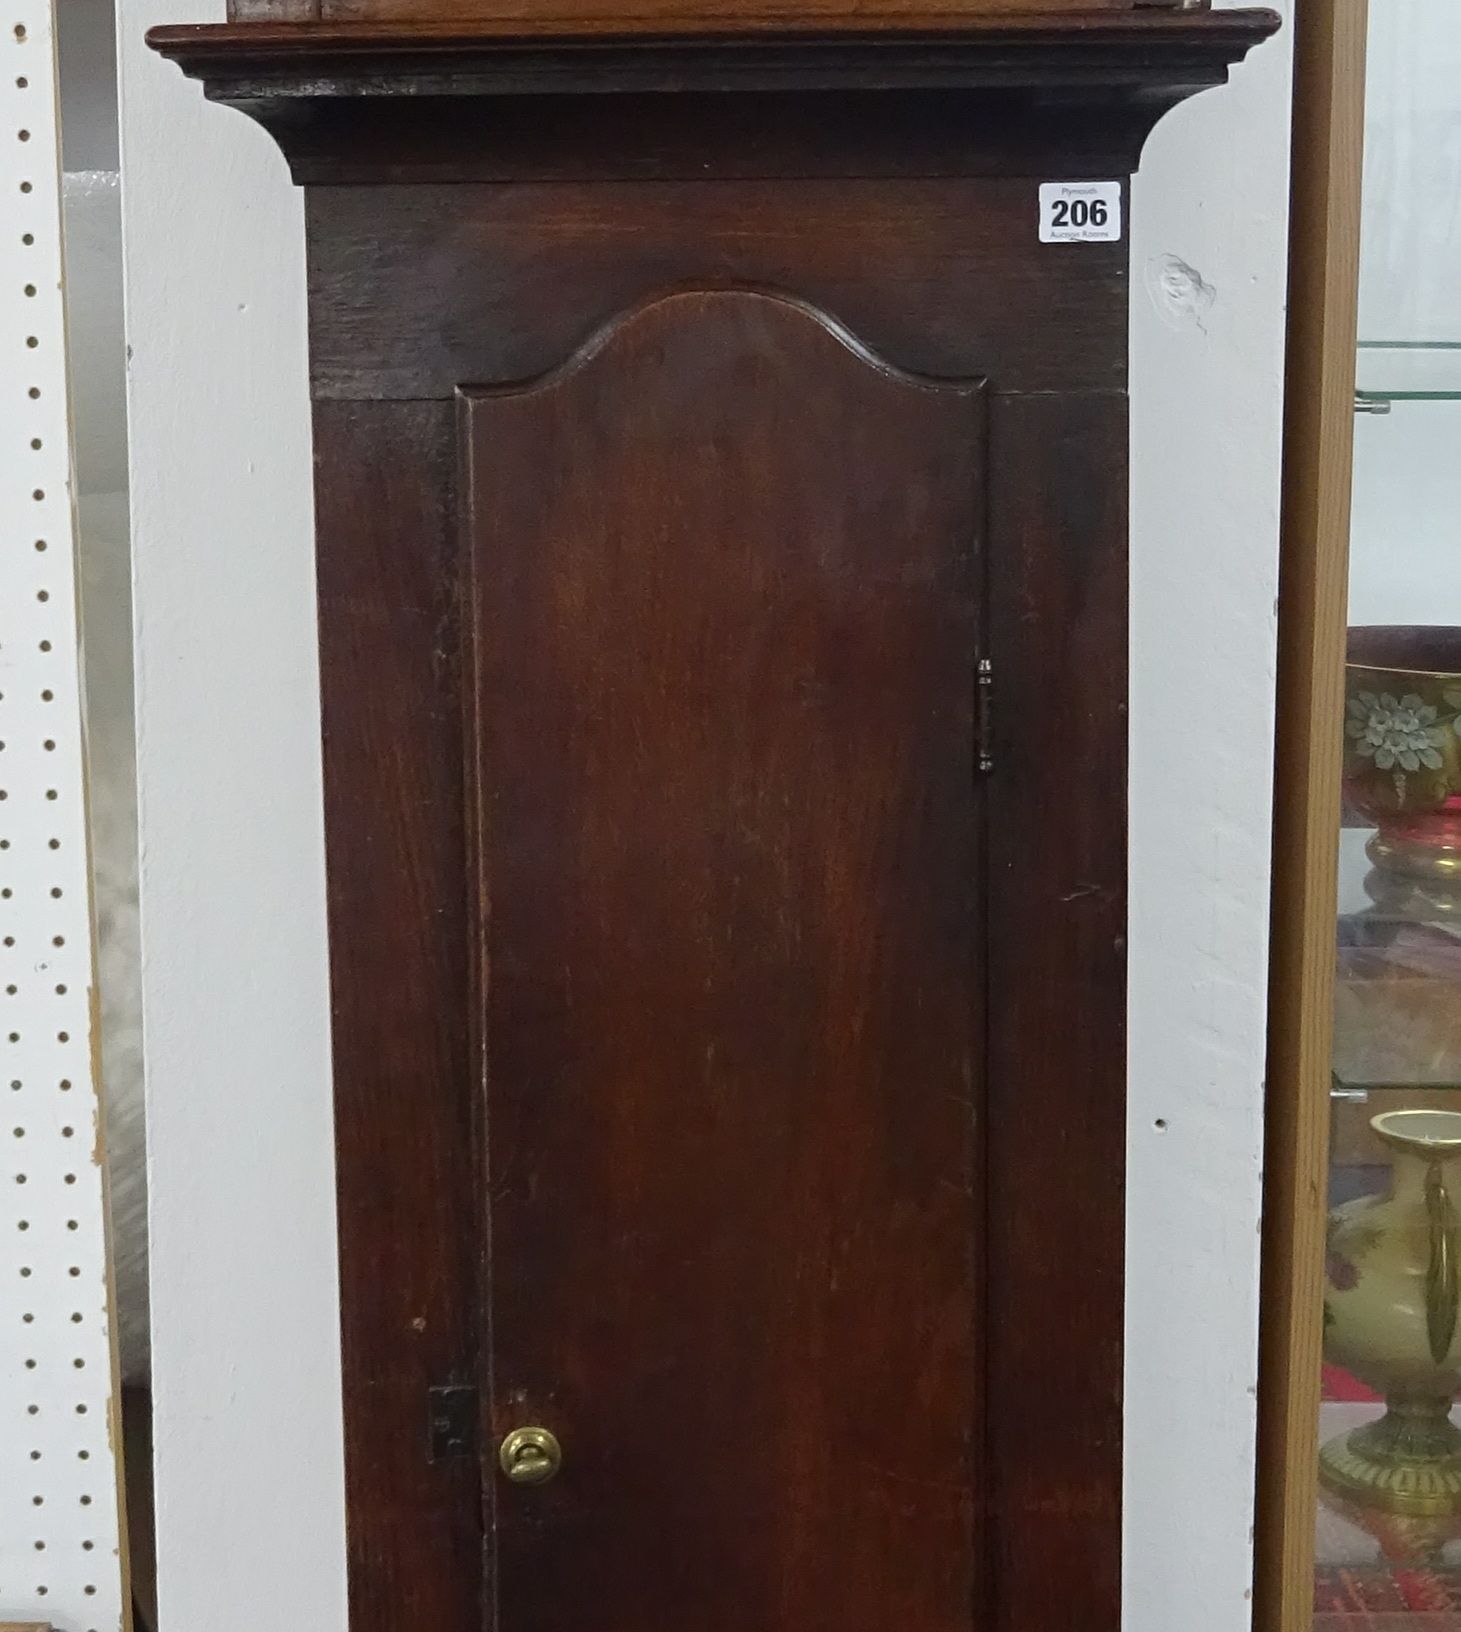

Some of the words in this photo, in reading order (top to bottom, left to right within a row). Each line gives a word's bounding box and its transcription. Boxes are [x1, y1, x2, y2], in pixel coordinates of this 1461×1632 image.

[1061, 188, 1098, 197] Plymouth
[1051, 199, 1107, 227] 206
[1082, 230, 1109, 238] Rooms
